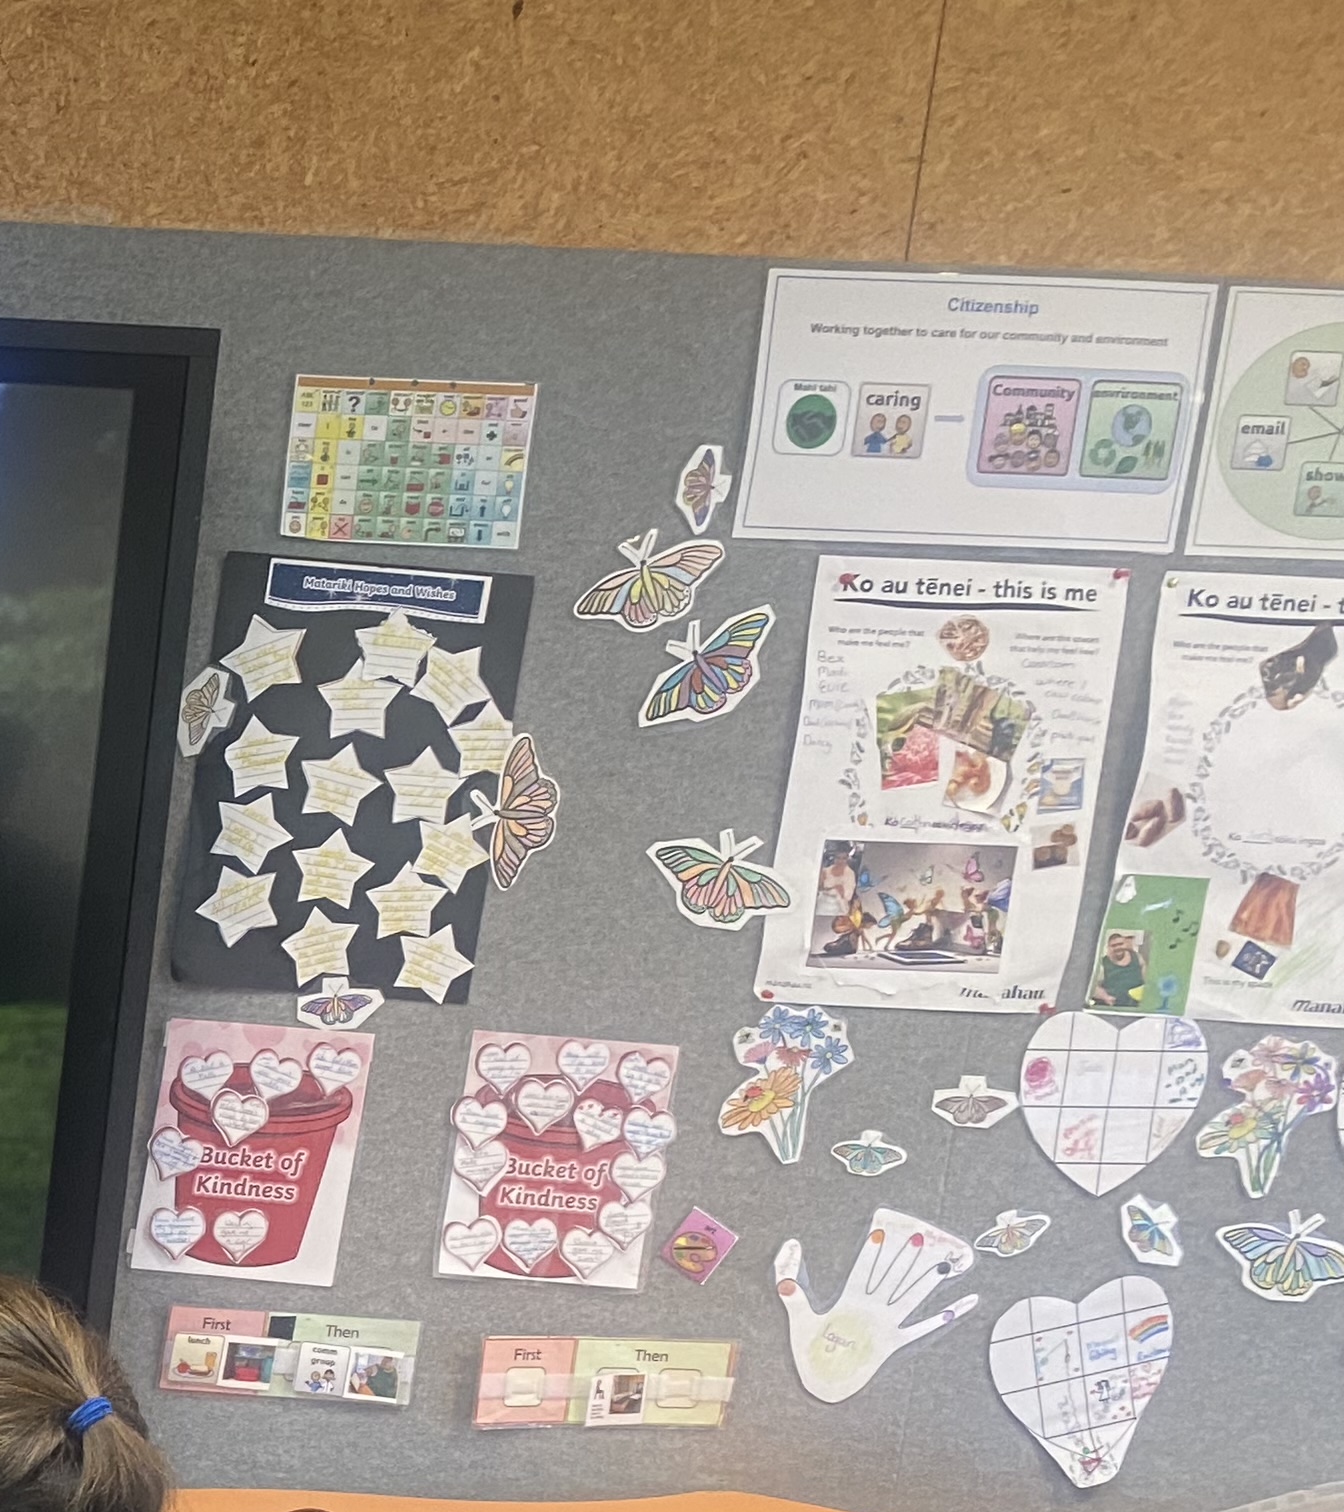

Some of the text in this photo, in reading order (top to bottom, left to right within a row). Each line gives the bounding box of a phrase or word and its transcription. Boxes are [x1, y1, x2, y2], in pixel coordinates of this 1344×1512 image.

[948, 297, 1039, 317] Citizenship
[811, 323, 1169, 347] Working together to care for our community and environment
[866, 390, 921, 412] caring
[992, 384, 1075, 402] Community
[1240, 421, 1286, 435] email
[303, 577, 456, 600] Matariki Hopes and Wishes
[880, 579, 909, 594] au
[915, 577, 973, 597] tēnei
[993, 578, 1033, 599] this
[1041, 580, 1057, 600] is
[1064, 587, 1097, 602] me
[1187, 588, 1220, 607] Ko
[1226, 594, 1253, 609] au
[1258, 593, 1317, 612] tēnei
[1292, 999, 1344, 1014] Mana
[201, 1146, 306, 1178] Bucket of
[507, 1157, 609, 1188] Bucket of
[196, 1175, 296, 1201] Kindness
[500, 1186, 598, 1211] Kindness
[202, 1317, 231, 1331] First
[325, 1324, 359, 1339] Then
[187, 1335, 211, 1345] lunch
[822, 1323, 856, 1353] Logan
[311, 1358, 336, 1368] group
[513, 1348, 543, 1362] First
[634, 1349, 669, 1363] Then
